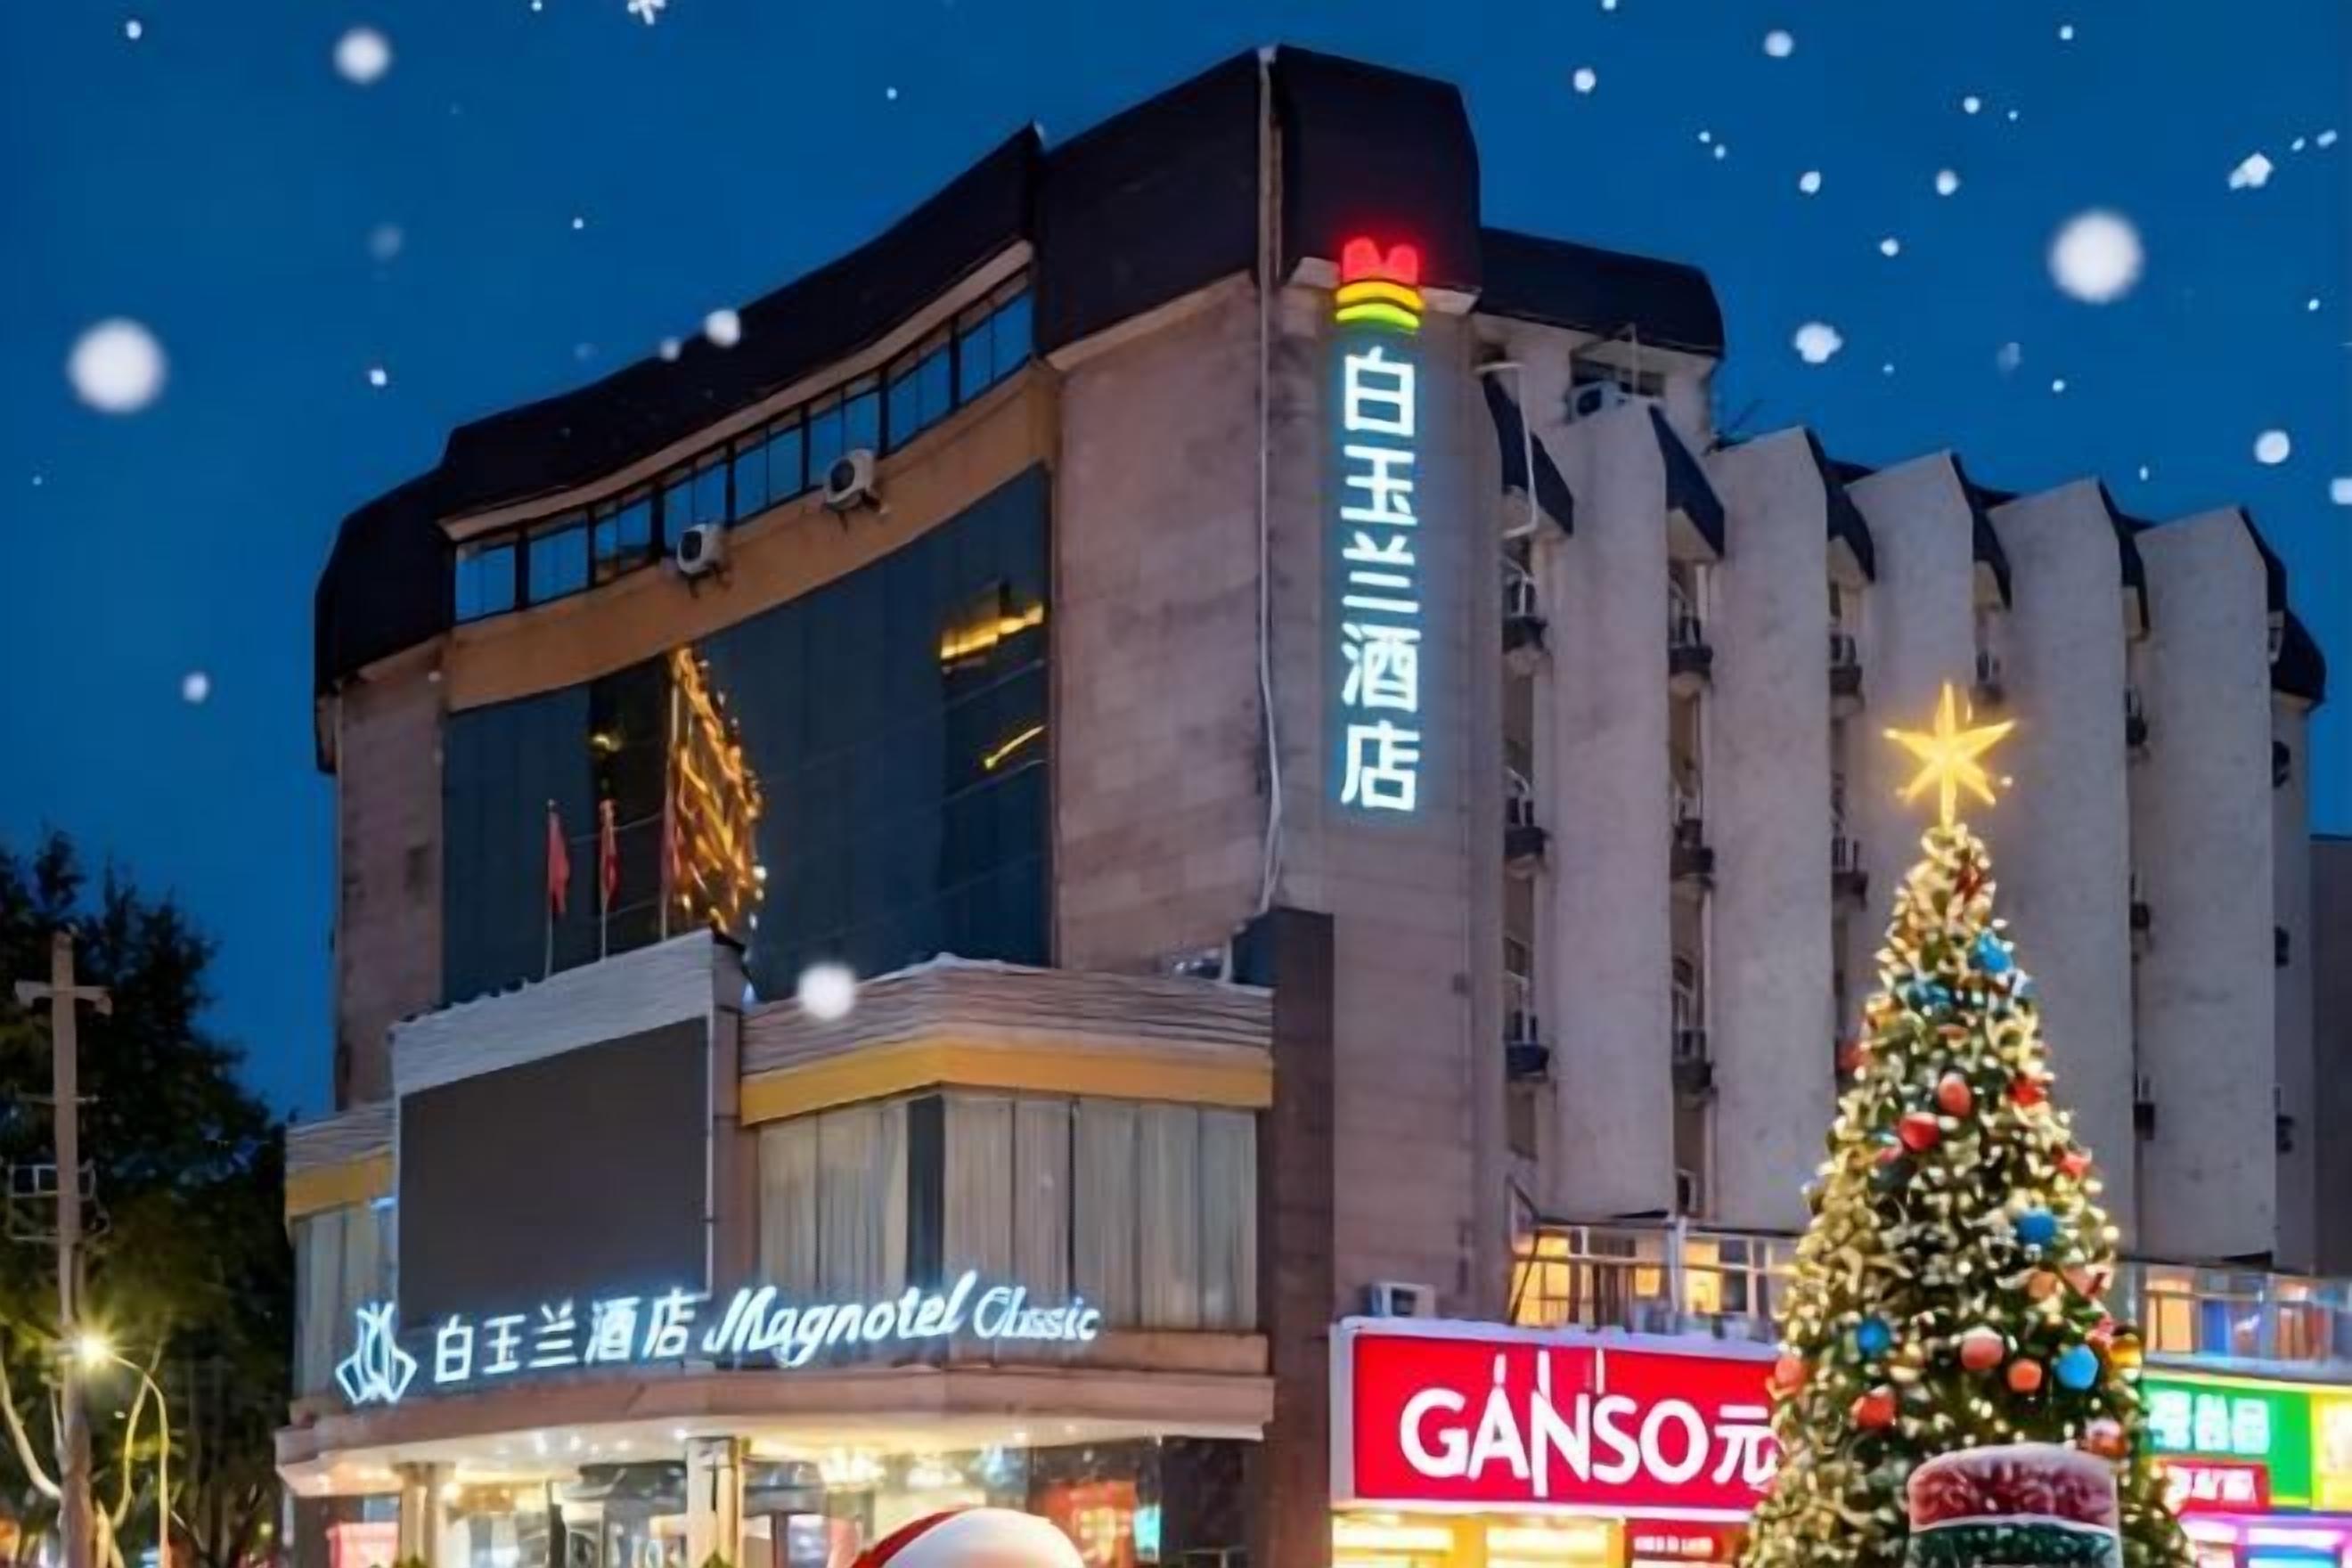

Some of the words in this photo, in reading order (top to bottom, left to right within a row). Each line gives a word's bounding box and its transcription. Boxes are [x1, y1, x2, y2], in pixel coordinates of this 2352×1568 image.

[1340, 346, 1422, 813] 白玉兰酒店
[434, 1286, 698, 1384] 白玉兰酒店
[702, 1269, 977, 1368] Magnotel
[973, 1286, 1102, 1341] Classic
[1399, 1348, 1711, 1498] GANSO
